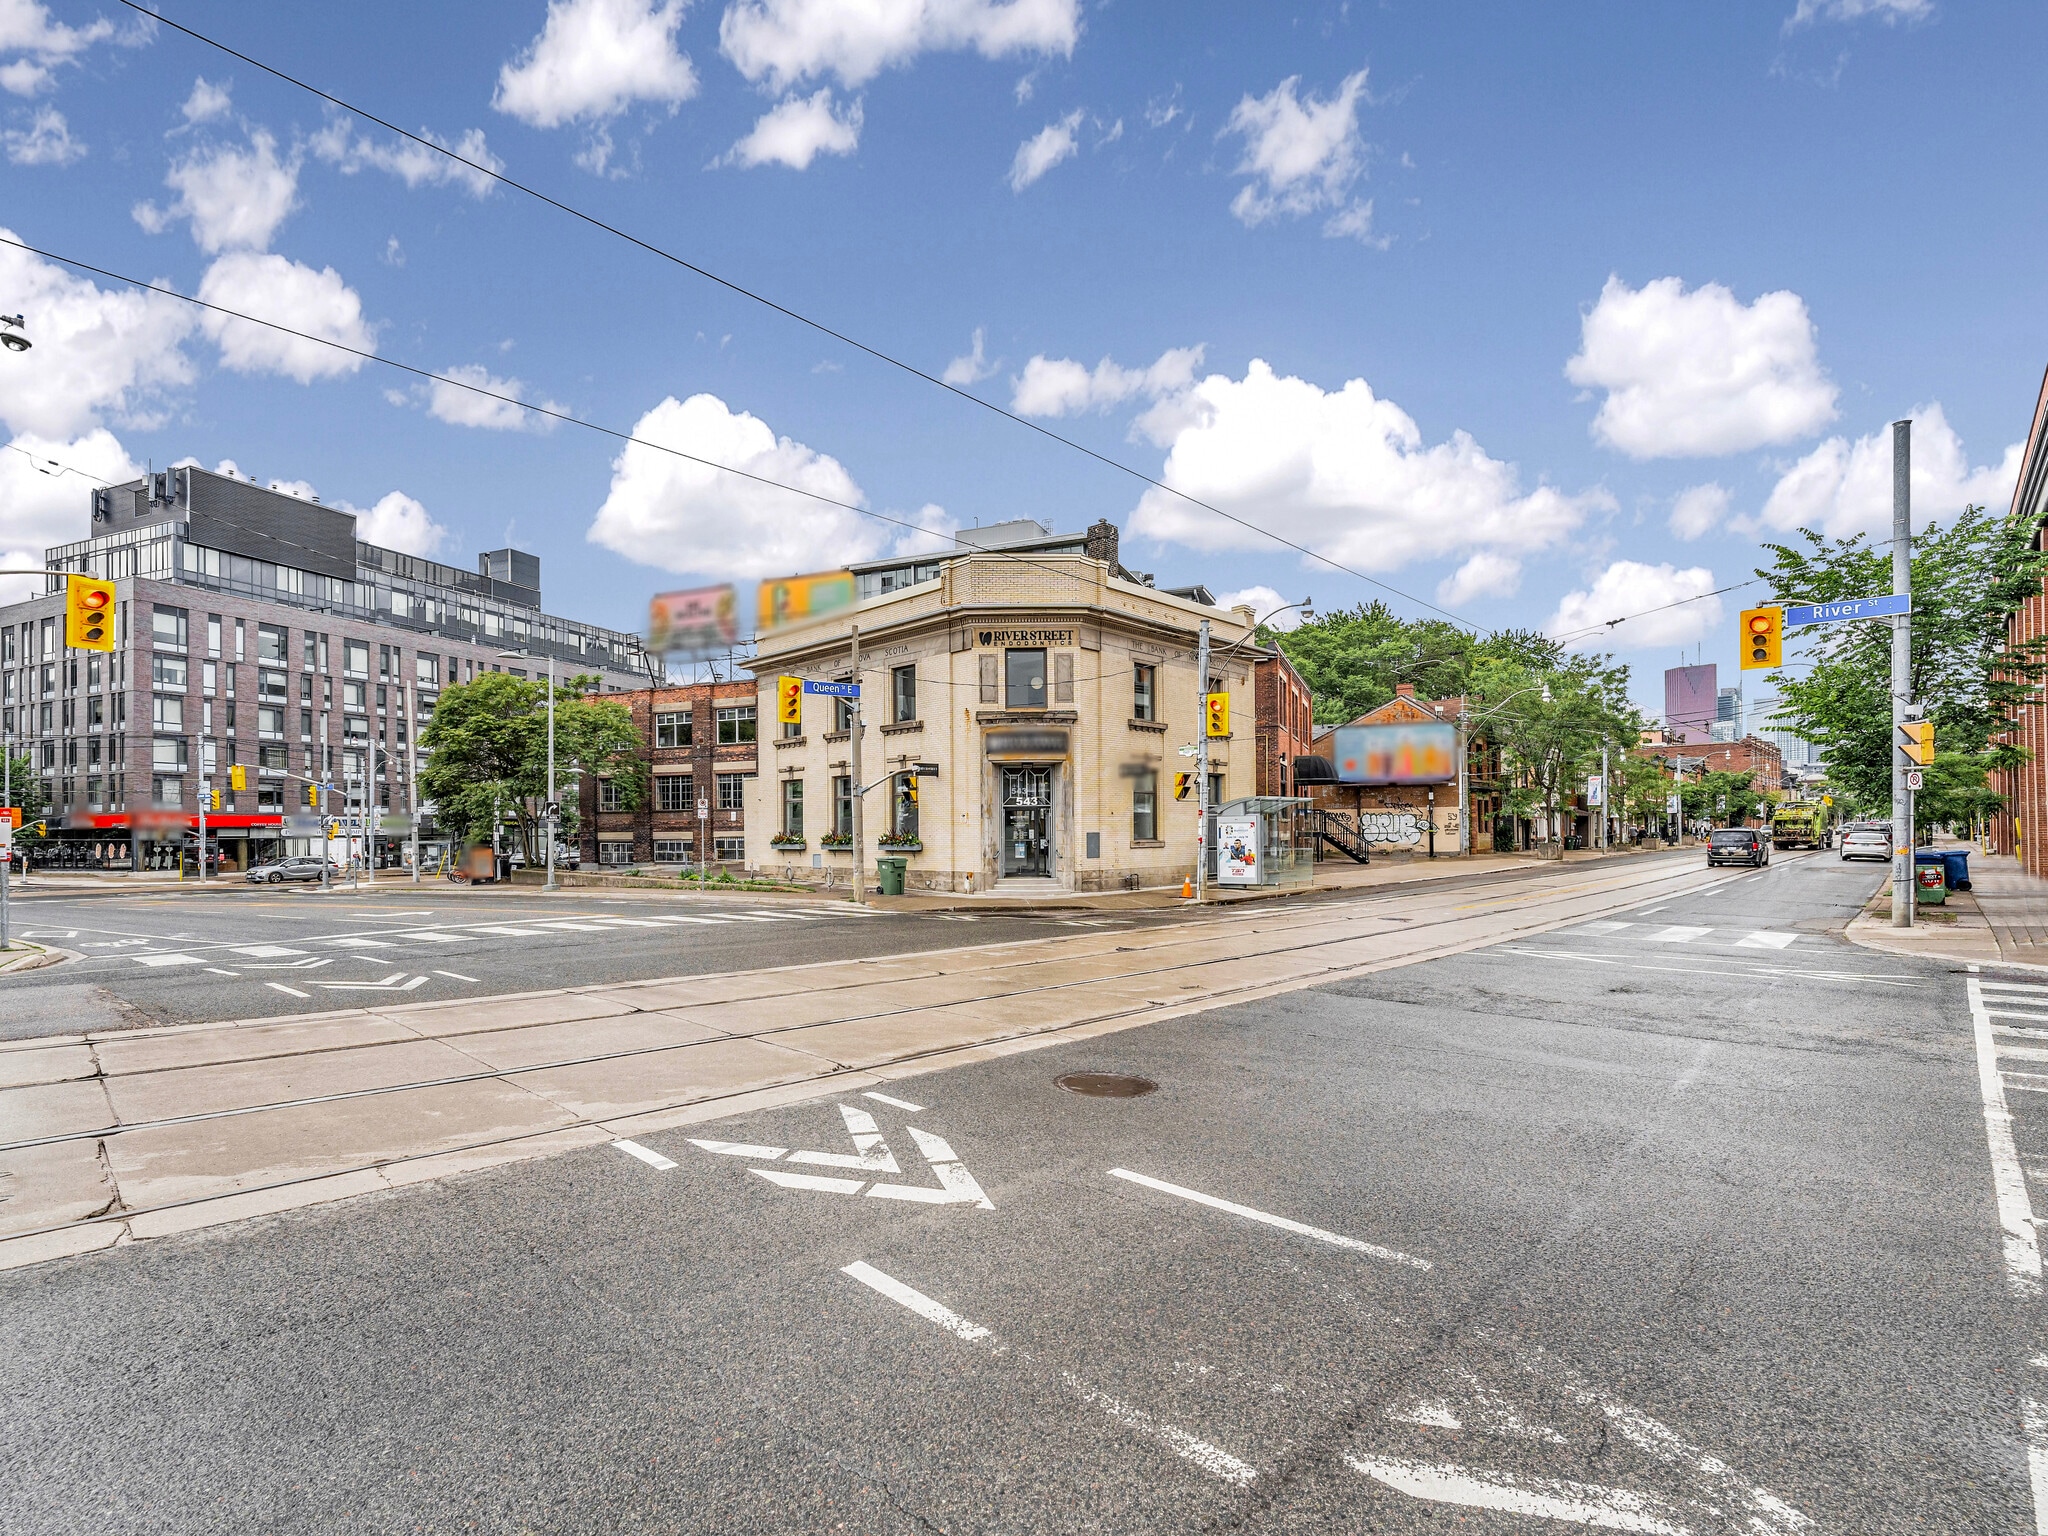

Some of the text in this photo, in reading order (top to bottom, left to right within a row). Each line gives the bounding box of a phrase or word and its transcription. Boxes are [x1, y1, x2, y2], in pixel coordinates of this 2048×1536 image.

[1813, 604, 1861, 619] River
[994, 630, 1073, 641] RIVER STREET
[1132, 641, 1143, 650] THE
[1151, 645, 1167, 656] BANK
[806, 664, 821, 673] BANK
[858, 653, 871, 662] OVA
[884, 645, 909, 657] SCOTIA
[812, 682, 840, 694] Queen
[847, 685, 852, 694] E
[1015, 796, 1038, 806] 543
